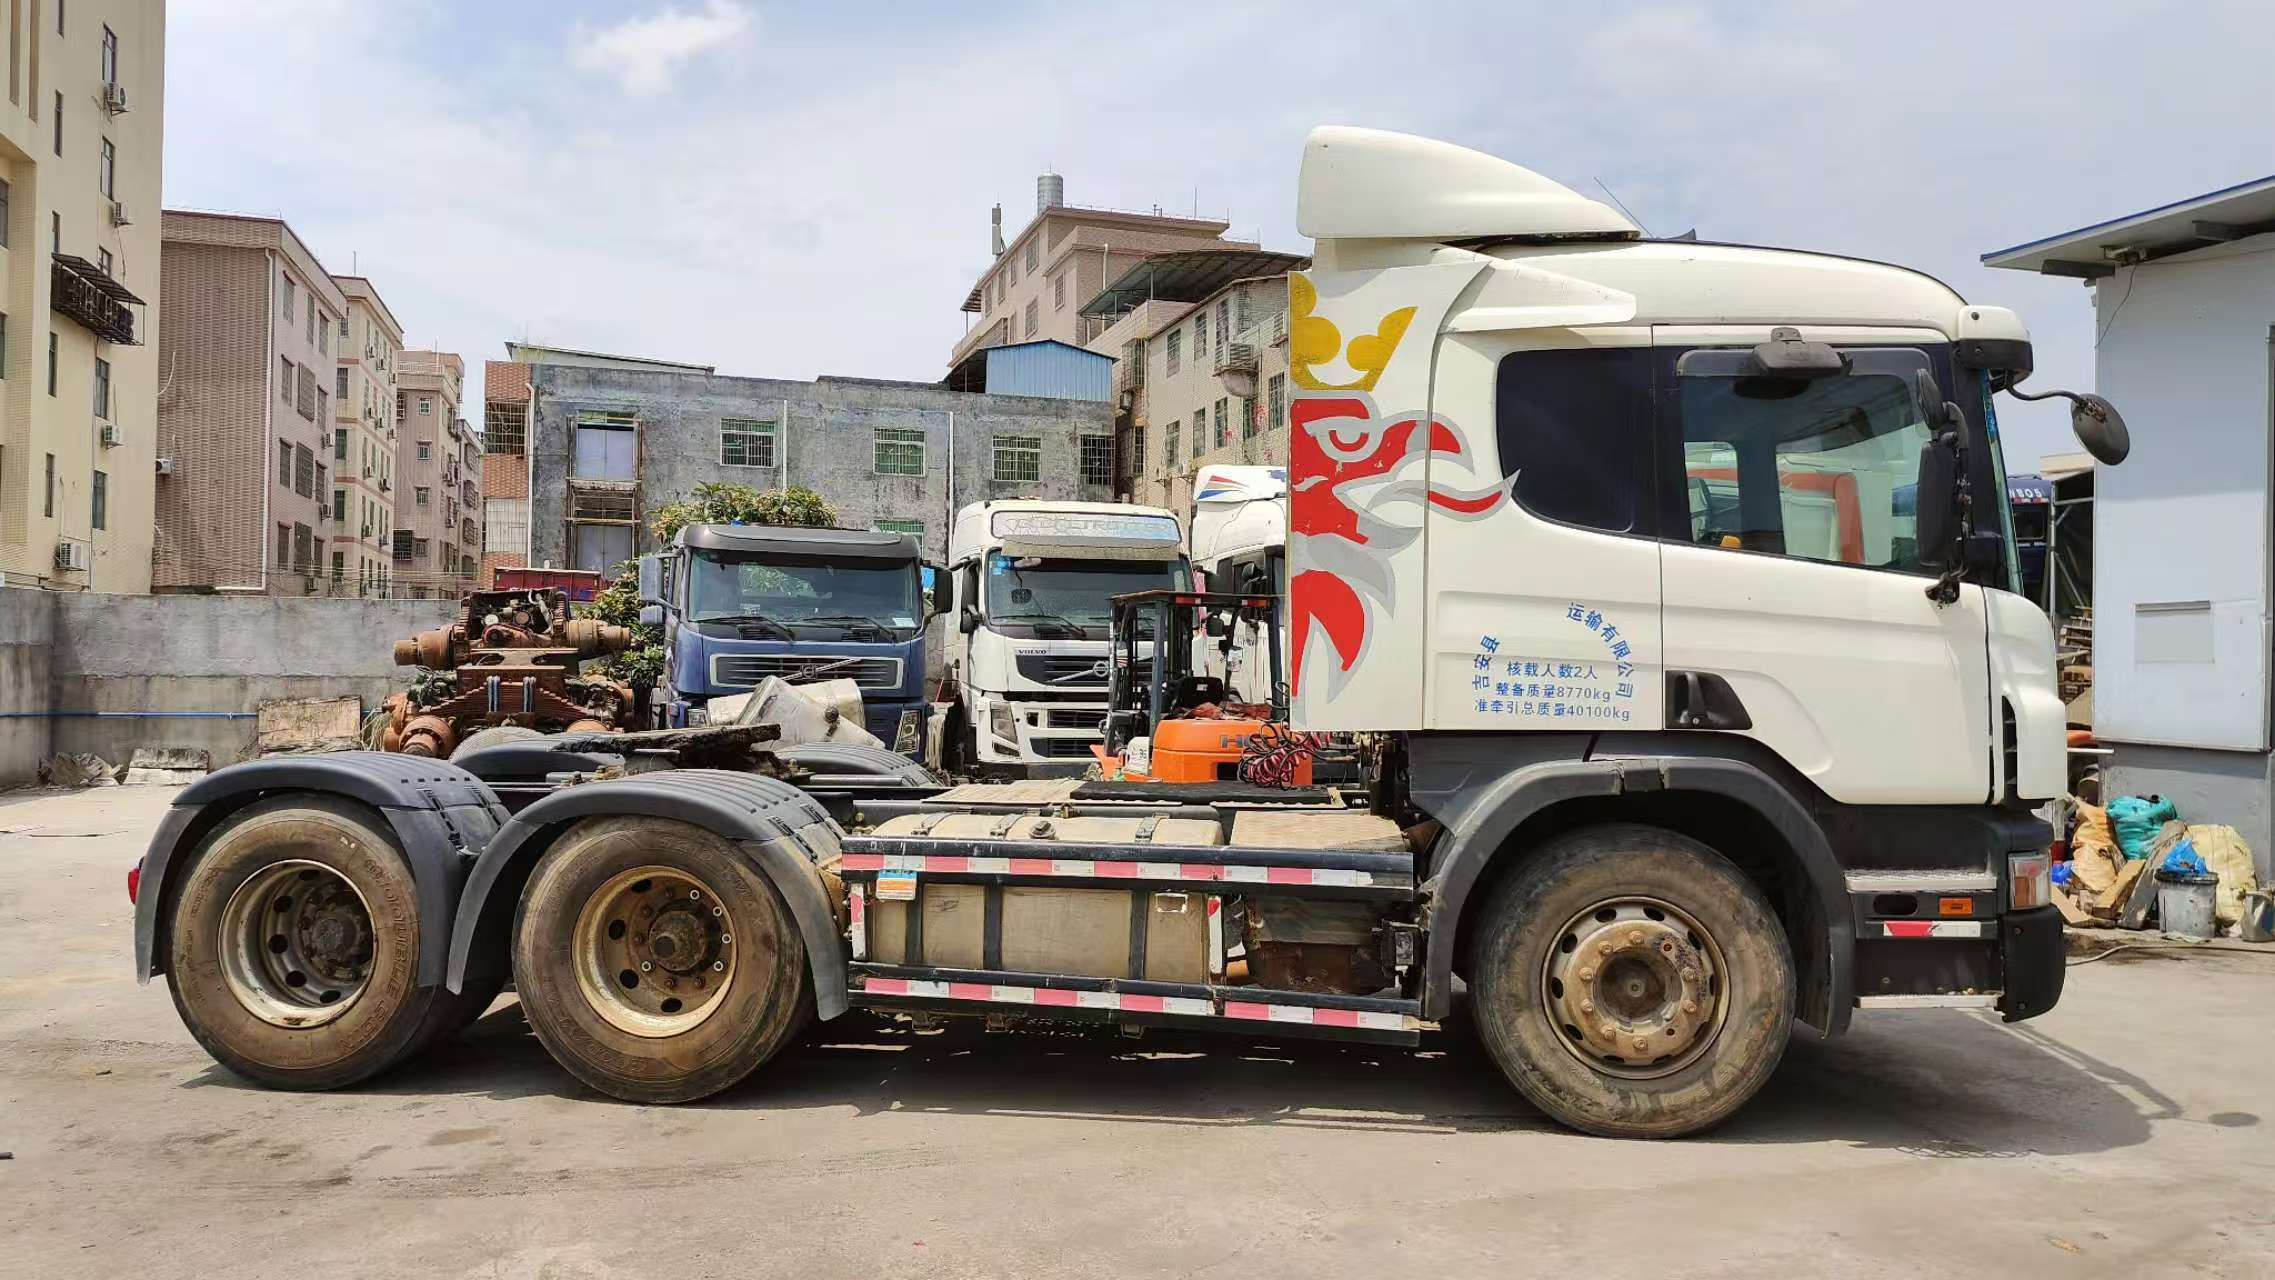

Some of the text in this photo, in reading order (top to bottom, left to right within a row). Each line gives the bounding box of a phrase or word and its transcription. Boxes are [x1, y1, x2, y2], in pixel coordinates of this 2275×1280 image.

[1472, 602, 1634, 698] 吉安县 运输有限公司
[1506, 661, 1598, 680] 核载人数2人
[1495, 682, 1611, 702] 整备质量8770kg
[1474, 699, 1631, 722] 准牵引总质量40100kg
